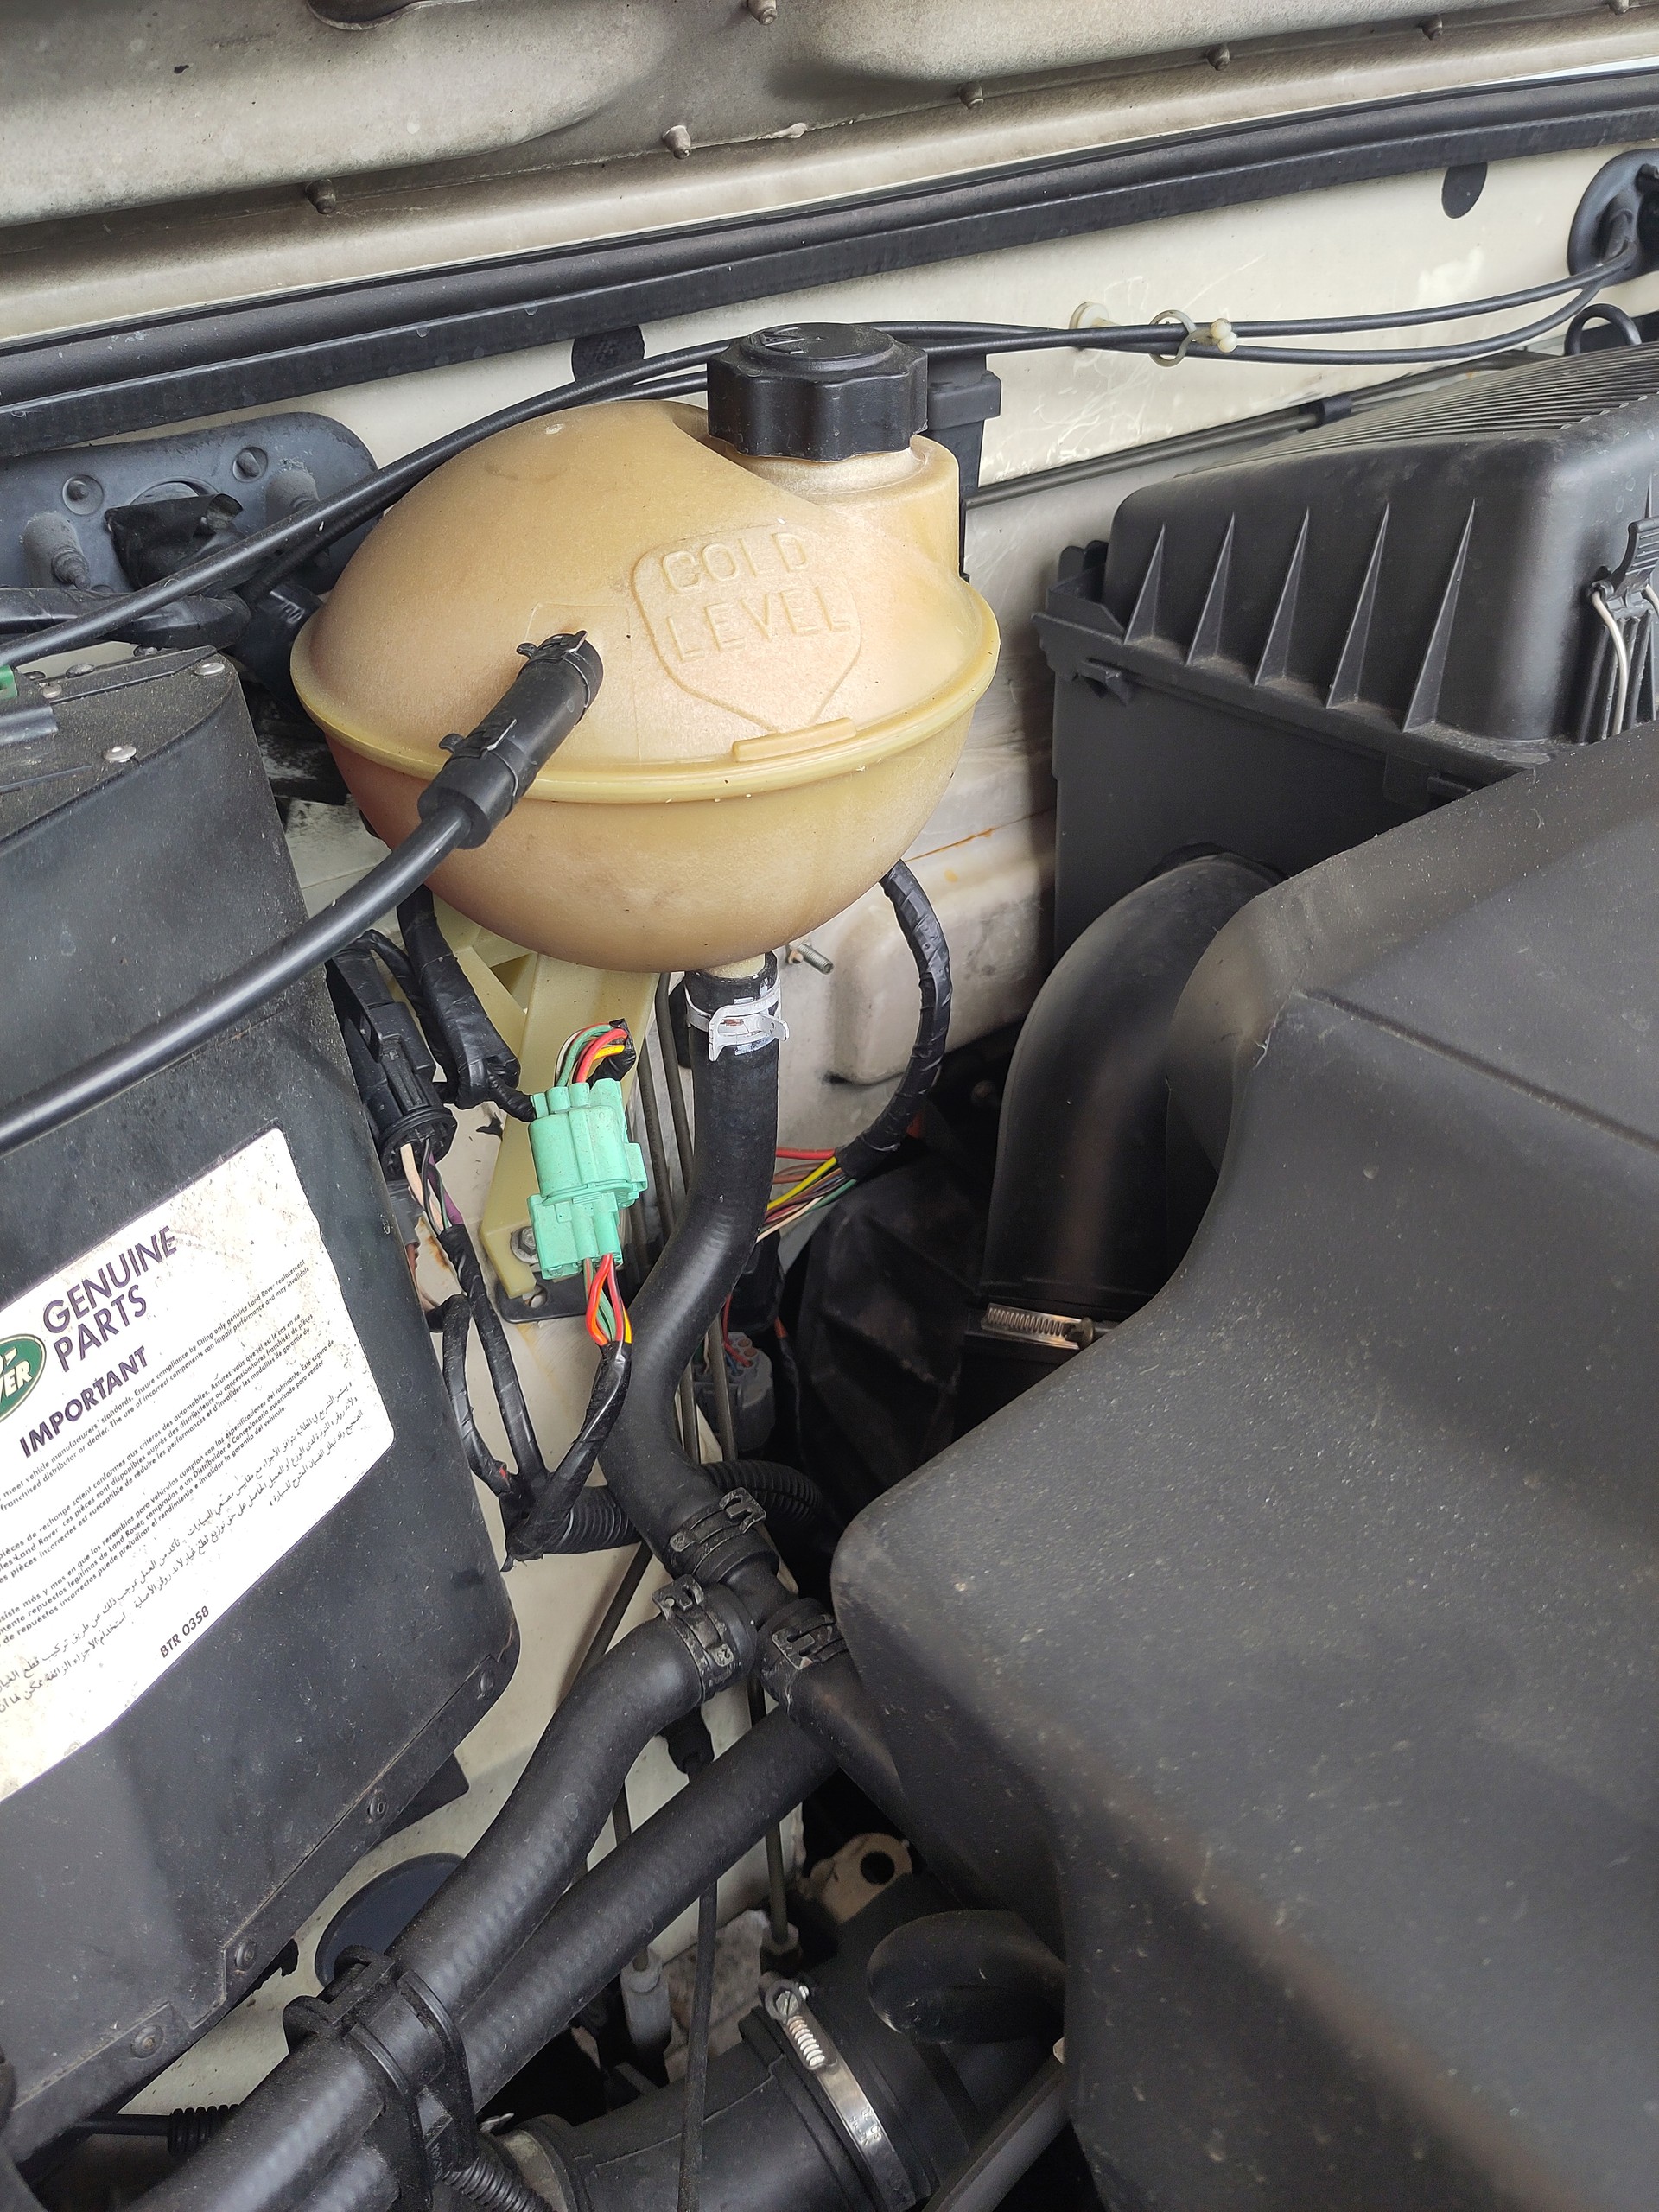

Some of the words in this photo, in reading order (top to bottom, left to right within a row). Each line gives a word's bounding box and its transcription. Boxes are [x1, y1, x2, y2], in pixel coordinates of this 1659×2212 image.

[661, 531, 809, 594] COLD
[664, 585, 852, 664] LEVEL
[3, 1479, 24, 1497] meet
[24, 1461, 49, 1483] vehicle
[100, 1395, 134, 1423] standards.
[133, 1377, 155, 1397] Ensure
[155, 1351, 188, 1380] compliance
[188, 1344, 196, 1353] by
[195, 1332, 214, 1346] fitting
[213, 1321, 226, 1334] only
[226, 1305, 248, 1326] genuine
[275, 1258, 305, 1285] replacement
[43, 1225, 178, 1333] GENUINE
[53, 1284, 147, 1372] PARTS
[0, 1478, 41, 1511] franchised
[41, 1452, 76, 1482] distributor
[78, 1444, 86, 1453] or
[86, 1427, 110, 1446] dealer.
[108, 1415, 123, 1427] The
[122, 1406, 135, 1418] use
[135, 1396, 143, 1408] of
[142, 1376, 168, 1402] incorrect
[168, 1351, 204, 1381] components
[203, 1342, 215, 1353] can
[213, 1327, 232, 1344] impair
[232, 1302, 265, 1333] performance
[264, 1293, 276, 1306] and
[275, 1285, 287, 1296] may
[286, 1266, 309, 1287] invalidate
[10, 1556, 37, 1578] pièces
[38, 1524, 77, 1557] incorrectes
[77, 1514, 88, 1527] est
[88, 1484, 124, 1517] susceptible
[124, 1477, 133, 1487] de
[133, 1458, 156, 1479] réduire
[155, 1449, 166, 1459] les
[166, 1415, 206, 1453] performances
[206, 1408, 213, 1418] et
[212, 1384, 242, 1412] d'invalider
[240, 1377, 251, 1387] les
[250, 1357, 276, 1380] modalités
[272, 1350, 283, 1359] de
[282, 1332, 303, 1355] garantie
[302, 1325, 310, 1336] du
[19, 1345, 148, 1458] IMPORTANT
[26, 1531, 37, 1541] de
[38, 1504, 71, 1533] rechange
[71, 1485, 92, 1506] soient
[92, 1459, 126, 1489] conformes
[138, 1429, 162, 1450] critères
[162, 1419, 173, 1431] des
[173, 1389, 210, 1421] automobiles.
[245, 1351, 256, 1363] que
[263, 1336, 272, 1347] est
[276, 1325, 287, 1336] cas
[285, 1319, 294, 1328] en
[293, 1313, 301, 1322] ne
[61, 1515, 73, 1527] ces
[73, 1497, 95, 1518] pièces
[95, 1483, 111, 1498] sont
[110, 1454, 146, 1486] disponibles
[146, 1436, 168, 1456] auprès
[167, 1426, 179, 1438] des
[179, 1396, 214, 1428] distributeurs
[214, 1389, 223, 1399] ou
[222, 1353, 266, 1392] concessionnaires
[264, 1332, 291, 1356] franchisés
[289, 1326, 298, 1335] de
[297, 1313, 313, 1331] pièces
[67, 1566, 76, 1576] en
[76, 1554, 90, 1567] que
[89, 1544, 101, 1555] los
[101, 1515, 135, 1546] recambios
[134, 1501, 150, 1518] para
[178, 1454, 204, 1478] cumplan
[203, 1445, 215, 1457] con
[265, 1390, 276, 1402] del
[274, 1370, 302, 1394] fabricante.
[310, 1345, 327, 1362] seguro
[327, 1338, 334, 1348] de
[98, 1551, 108, 1561] de
[144, 1489, 178, 1520] comprados
[183, 1476, 193, 1486] un
[192, 1446, 226, 1478] Distribuidor
[230, 1408, 269, 1444] Concesionario
[268, 1385, 296, 1411] autorizado
[295, 1374, 308, 1389] para
[306, 1359, 323, 1376] vender
[2, 1633, 15, 1643] de
[59, 1573, 97, 1607] incorrectos
[97, 1554, 118, 1577] puede
[118, 1525, 149, 1558] prejudicar
[150, 1516, 158, 1528] el
[157, 1487, 194, 1521] rendimiento
[198, 1459, 224, 1484] invalidar
[253, 1423, 264, 1435] del
[159, 1633, 181, 1658] BTR
